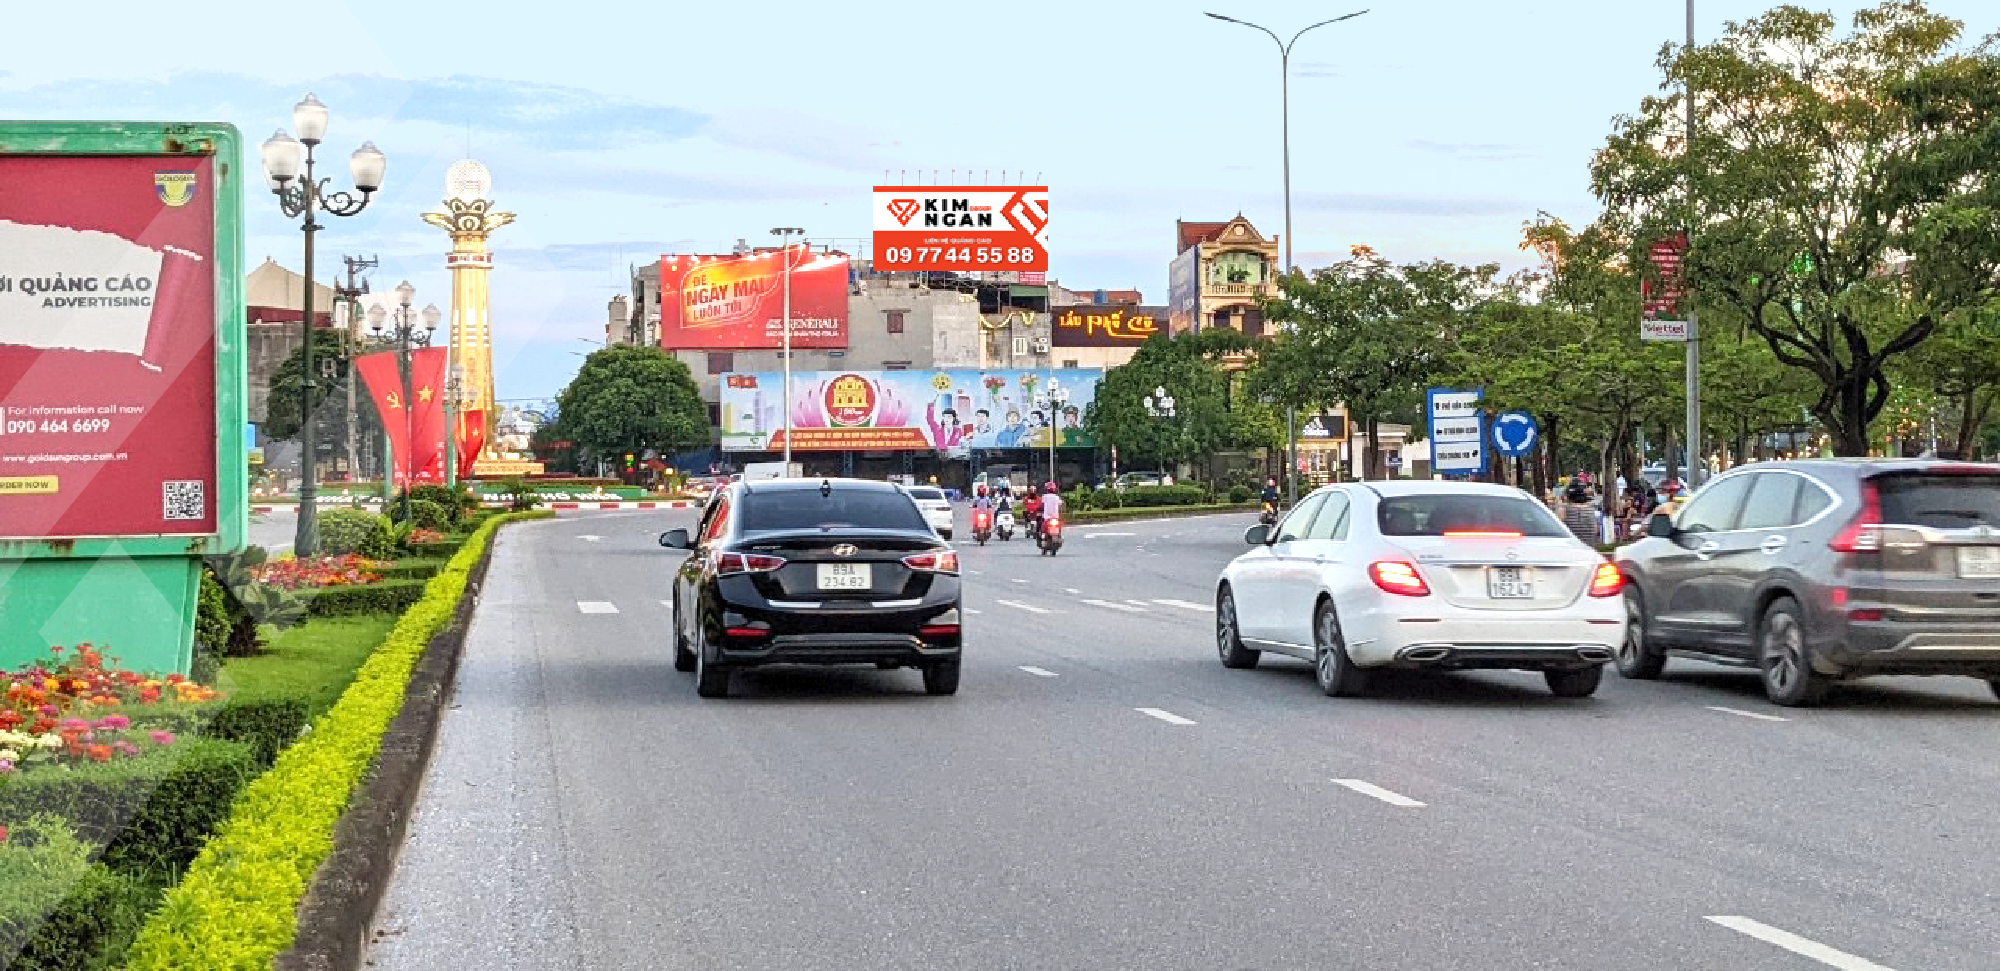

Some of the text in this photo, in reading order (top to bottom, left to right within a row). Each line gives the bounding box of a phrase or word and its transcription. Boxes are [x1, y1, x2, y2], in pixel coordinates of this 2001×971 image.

[925, 199, 970, 212] KIM
[925, 213, 993, 228] NGAN
[886, 247, 1034, 264] 09 77 44 55 88
[19, 272, 98, 296] QUẢNG
[105, 273, 152, 292] CÁO
[41, 296, 151, 308] ADVERTISING
[8, 404, 145, 415] For information call now
[7, 418, 111, 434] 090 464 6699
[24, 481, 50, 489] NOW
